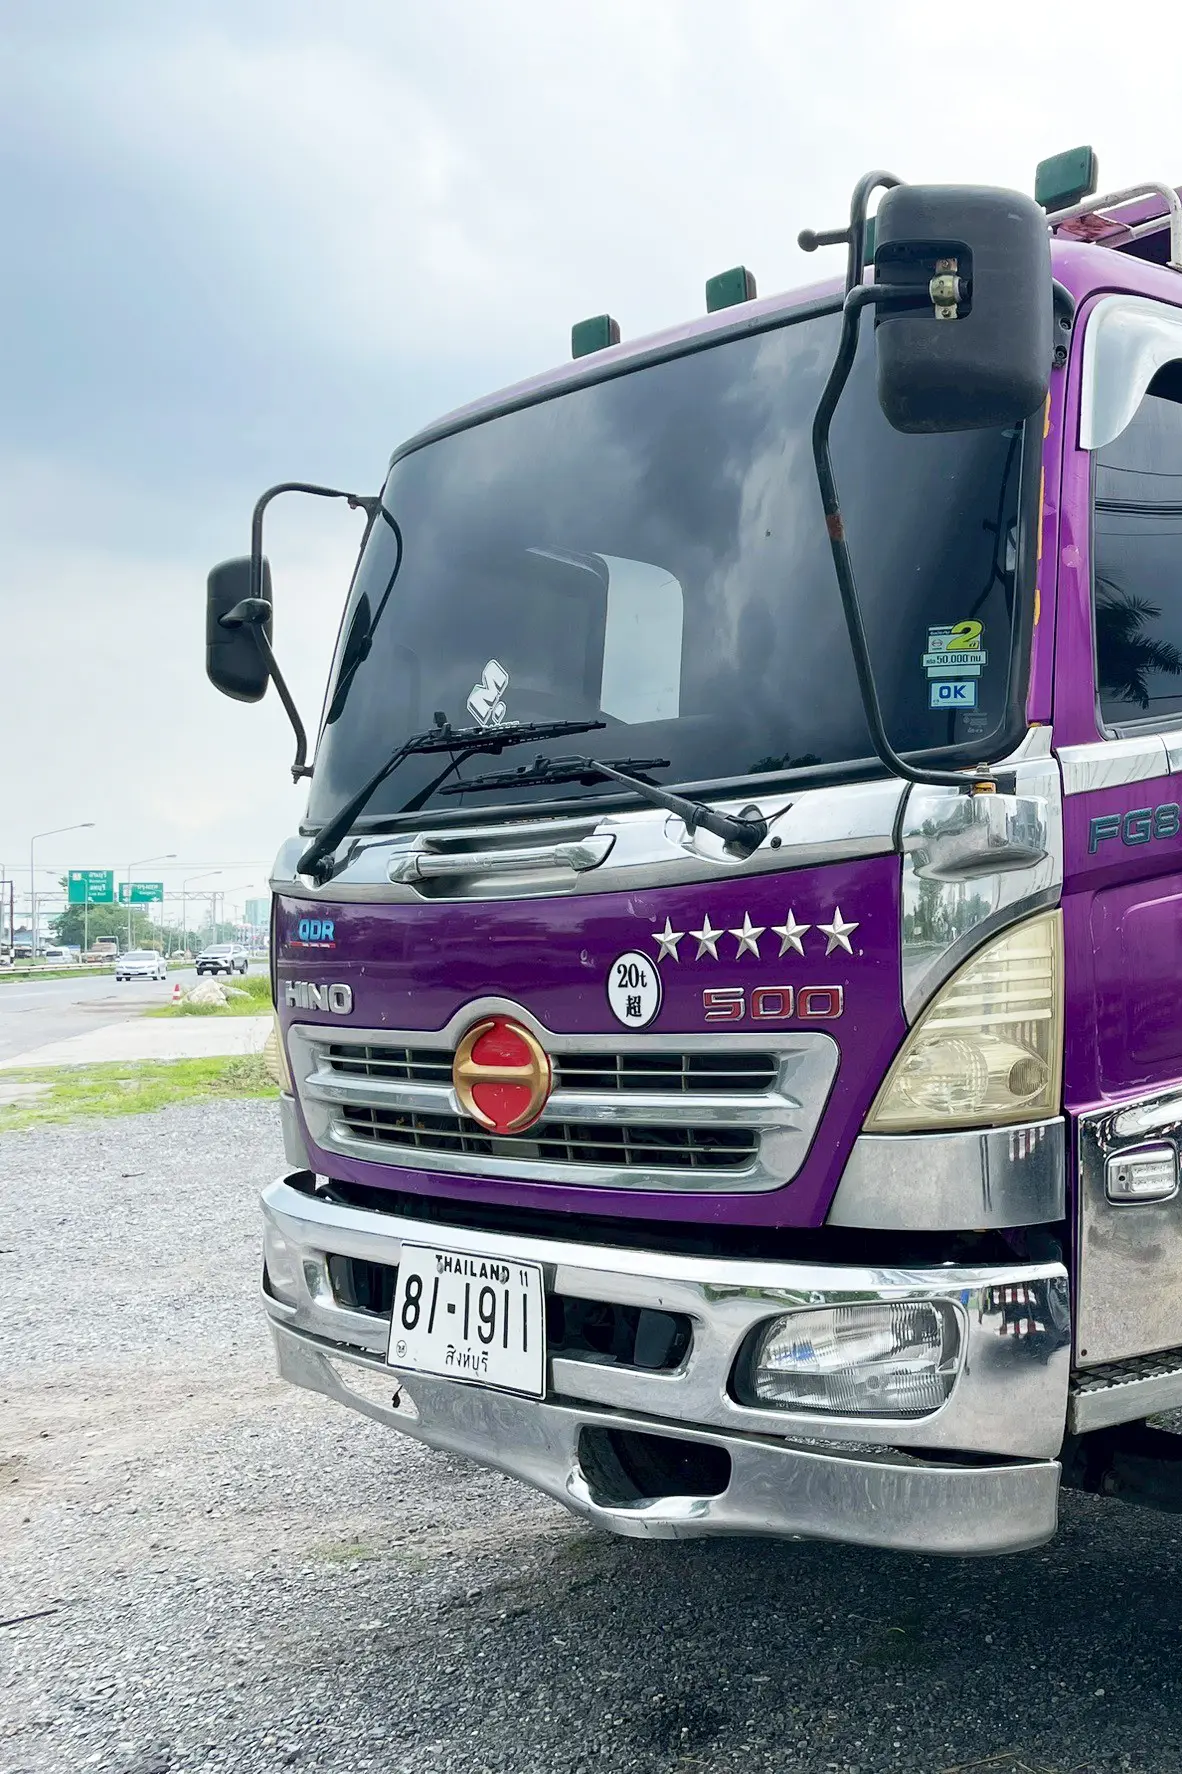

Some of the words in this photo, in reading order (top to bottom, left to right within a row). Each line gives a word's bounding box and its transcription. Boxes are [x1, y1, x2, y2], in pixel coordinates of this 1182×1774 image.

[946, 620, 982, 650] 2
[939, 685, 966, 699] OK
[298, 918, 335, 941] QDR
[617, 963, 647, 989] 20t
[285, 980, 354, 1015] HINO
[625, 995, 643, 1018] 超
[702, 985, 844, 1022] 500
[435, 1254, 510, 1284] THAILAND
[401, 1274, 528, 1353] 81-1911
